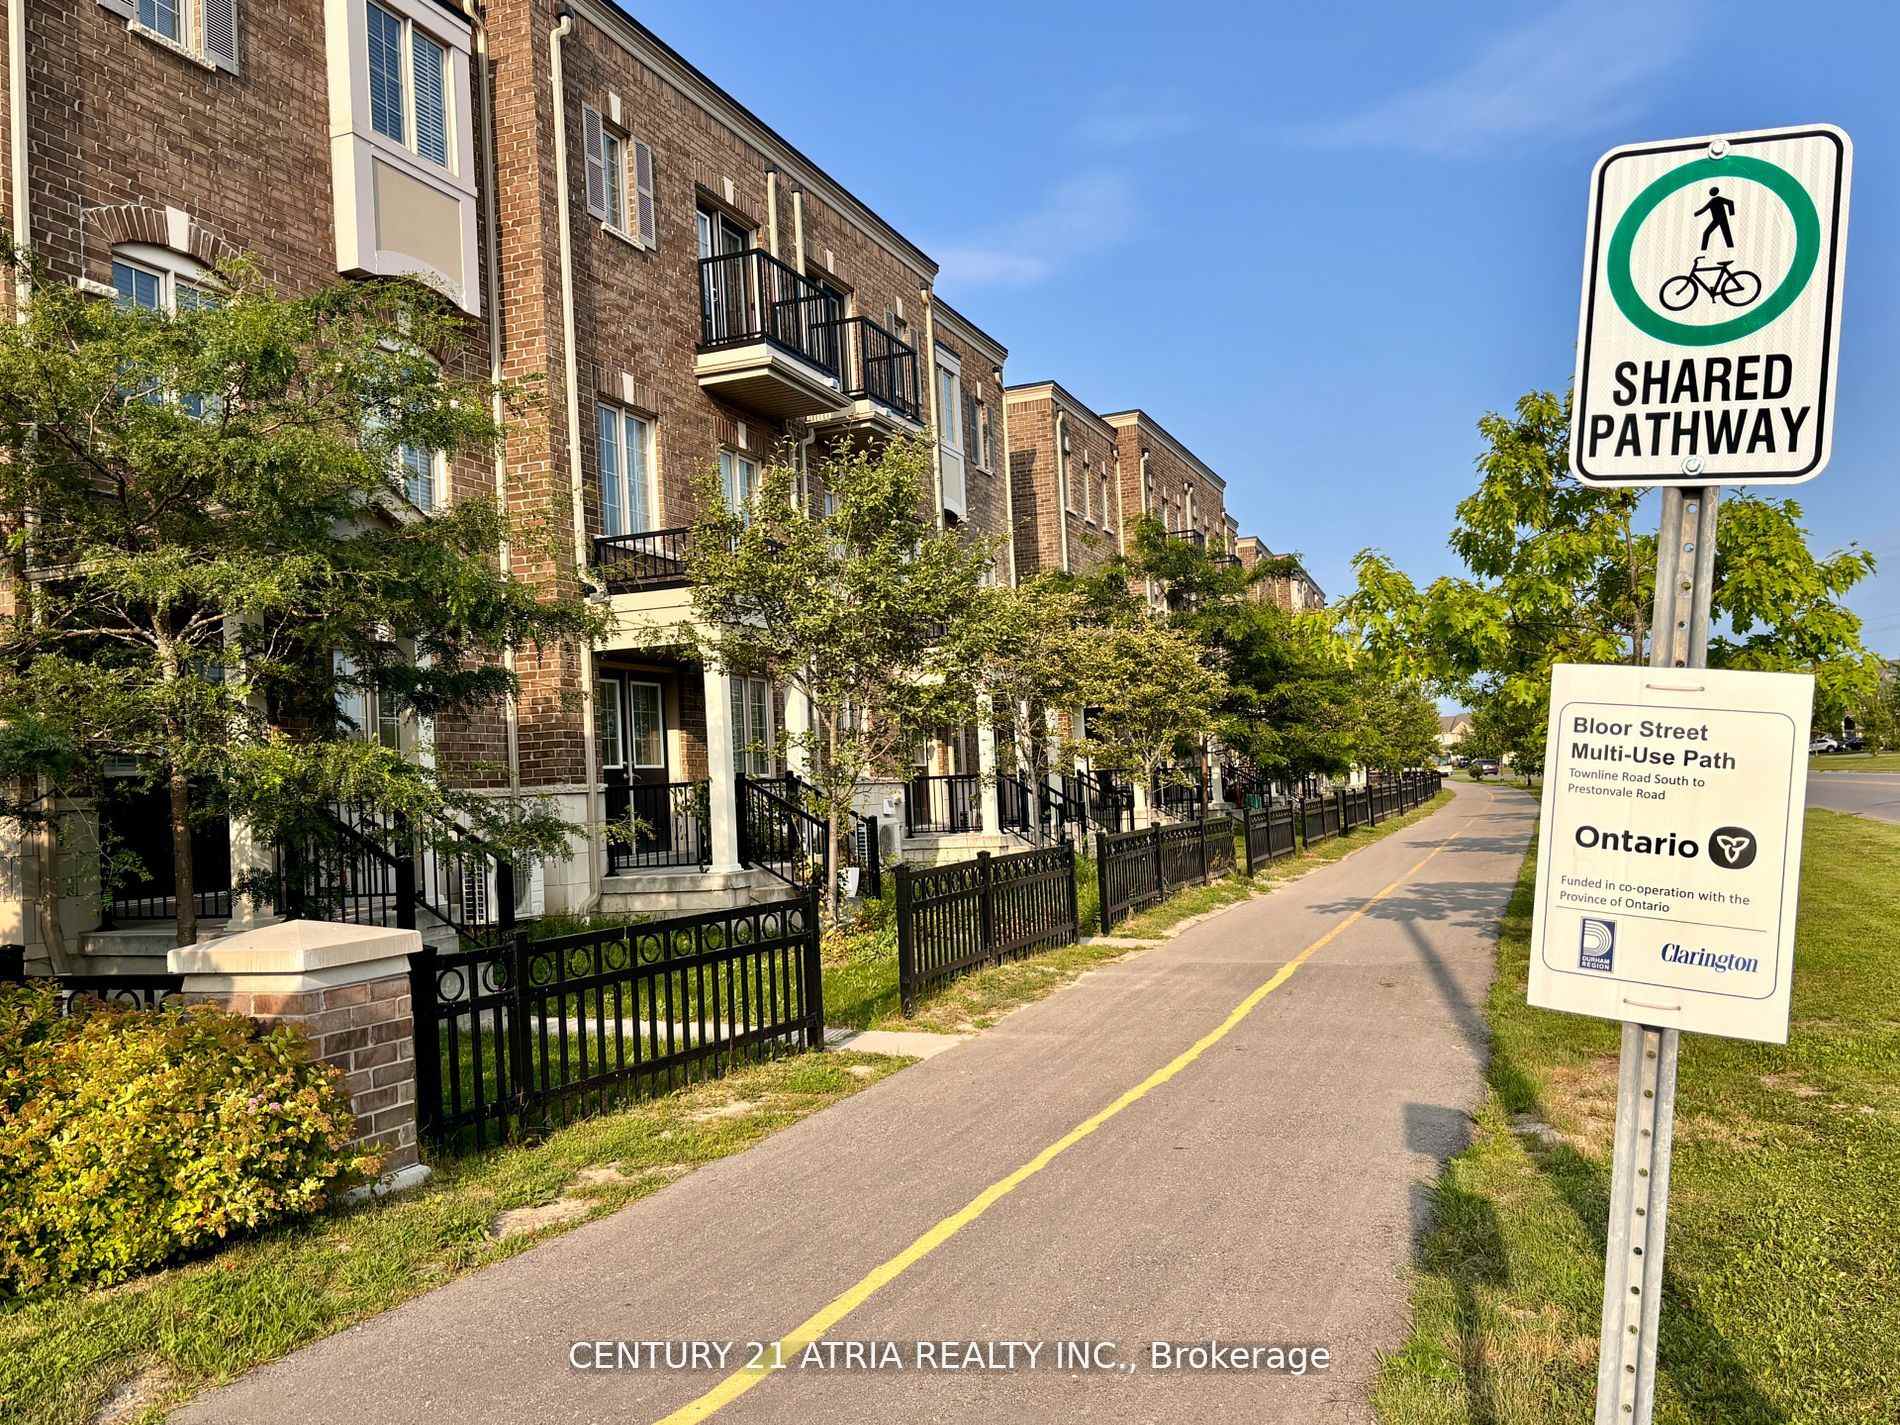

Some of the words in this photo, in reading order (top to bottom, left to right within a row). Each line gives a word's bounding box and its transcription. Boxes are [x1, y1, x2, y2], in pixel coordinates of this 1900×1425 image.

[1613, 354, 1792, 406] SHARED
[1589, 406, 1810, 457] PATHWAY
[1573, 717, 1632, 736] Bloor
[1640, 721, 1709, 741] Street
[1571, 742, 1675, 765] Multi-Use
[1684, 750, 1736, 770] Path
[1568, 784, 1633, 798] Prestonvale
[1636, 788, 1665, 800] Road
[1569, 768, 1618, 782] Townline
[1622, 771, 1651, 784] Road
[1654, 774, 1689, 786] South
[1693, 776, 1705, 788] to
[1575, 825, 1699, 858] Ontario
[1560, 891, 1607, 905] Province
[1610, 896, 1622, 907] of
[1625, 898, 1670, 913] Ontario
[1561, 875, 1602, 890] Funded
[1605, 880, 1615, 891] in
[1619, 883, 1694, 900] co-operation
[1698, 890, 1725, 903] with
[1729, 893, 1750, 906] the
[1581, 961, 1609, 970] REGION
[1661, 942, 1758, 973] Clarington
